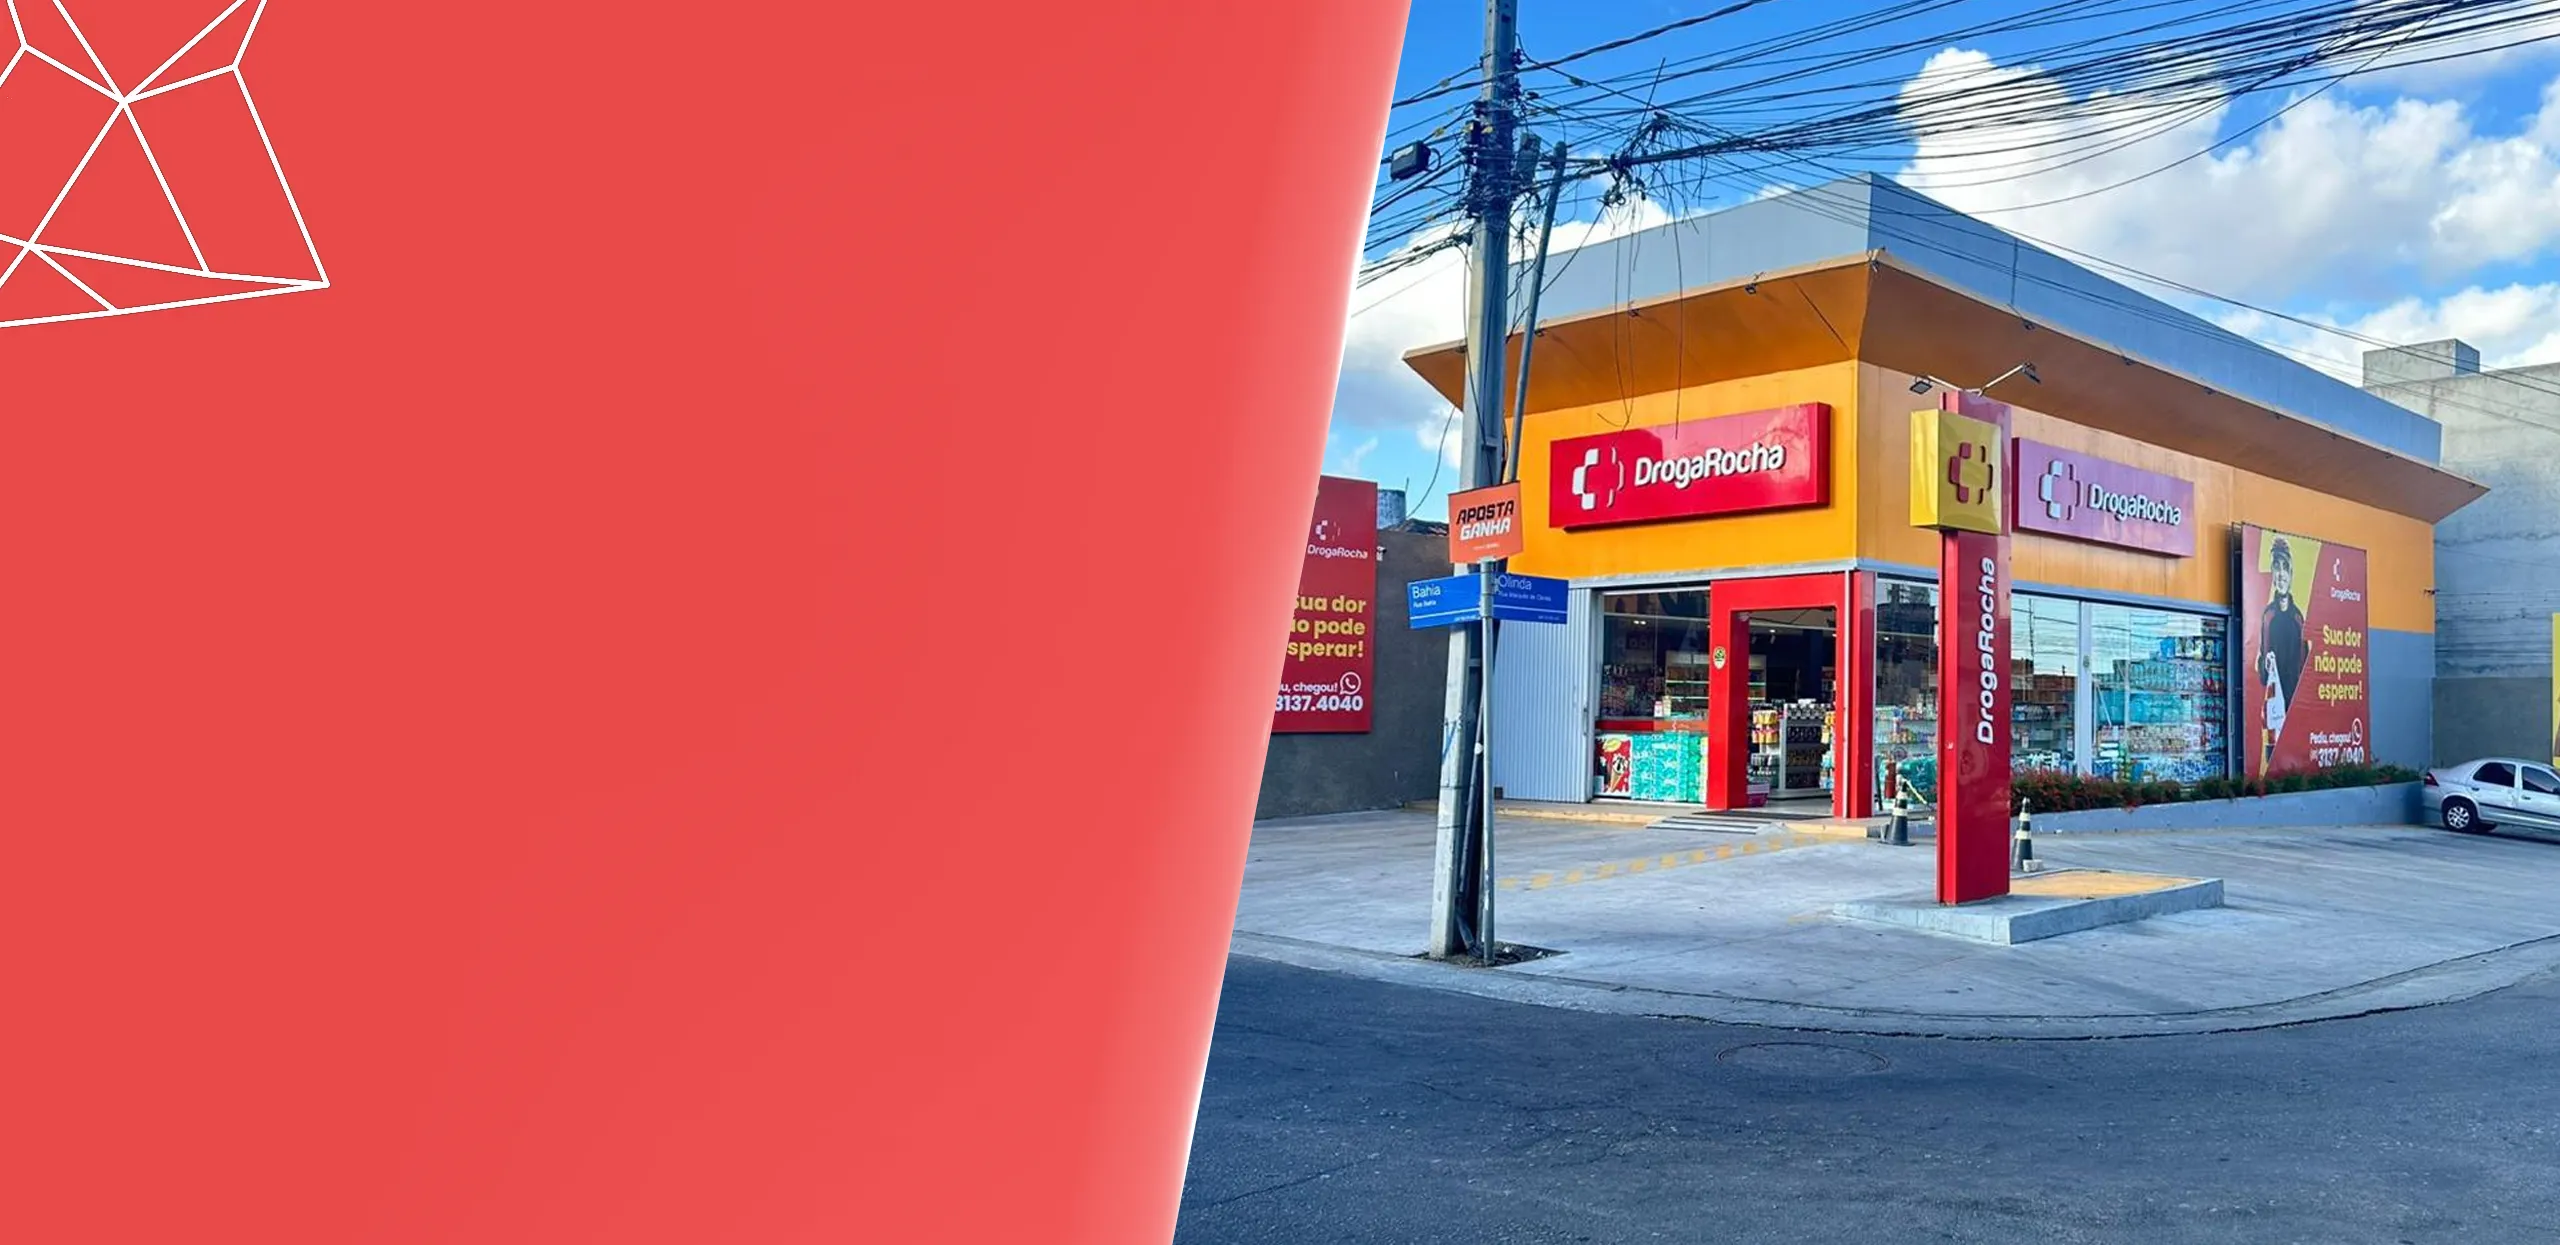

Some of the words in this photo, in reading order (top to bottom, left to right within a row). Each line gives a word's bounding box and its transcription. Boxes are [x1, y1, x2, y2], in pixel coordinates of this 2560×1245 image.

[1633, 440, 1786, 489] DrogaRocha
[1456, 500, 1514, 525] APOSTA
[2087, 482, 2182, 527] DrogaRocha
[1460, 517, 1511, 541] GANHA
[1307, 544, 1368, 559] DrogaRocha
[1412, 584, 1441, 599] Bahia
[1499, 574, 1532, 590] Olinda
[1331, 595, 1366, 613] dor
[1314, 618, 1365, 639] pode
[2323, 624, 2343, 646] Sua
[2344, 627, 2361, 647] dor
[1287, 640, 1363, 661] sperar!
[1977, 557, 1998, 744] DrogaRocha
[2315, 651, 2336, 672] não
[2338, 653, 2362, 680] pode
[1293, 682, 1338, 695] chegou!
[2318, 680, 2362, 707] esperar!
[1276, 695, 1363, 711] 3137.4040
